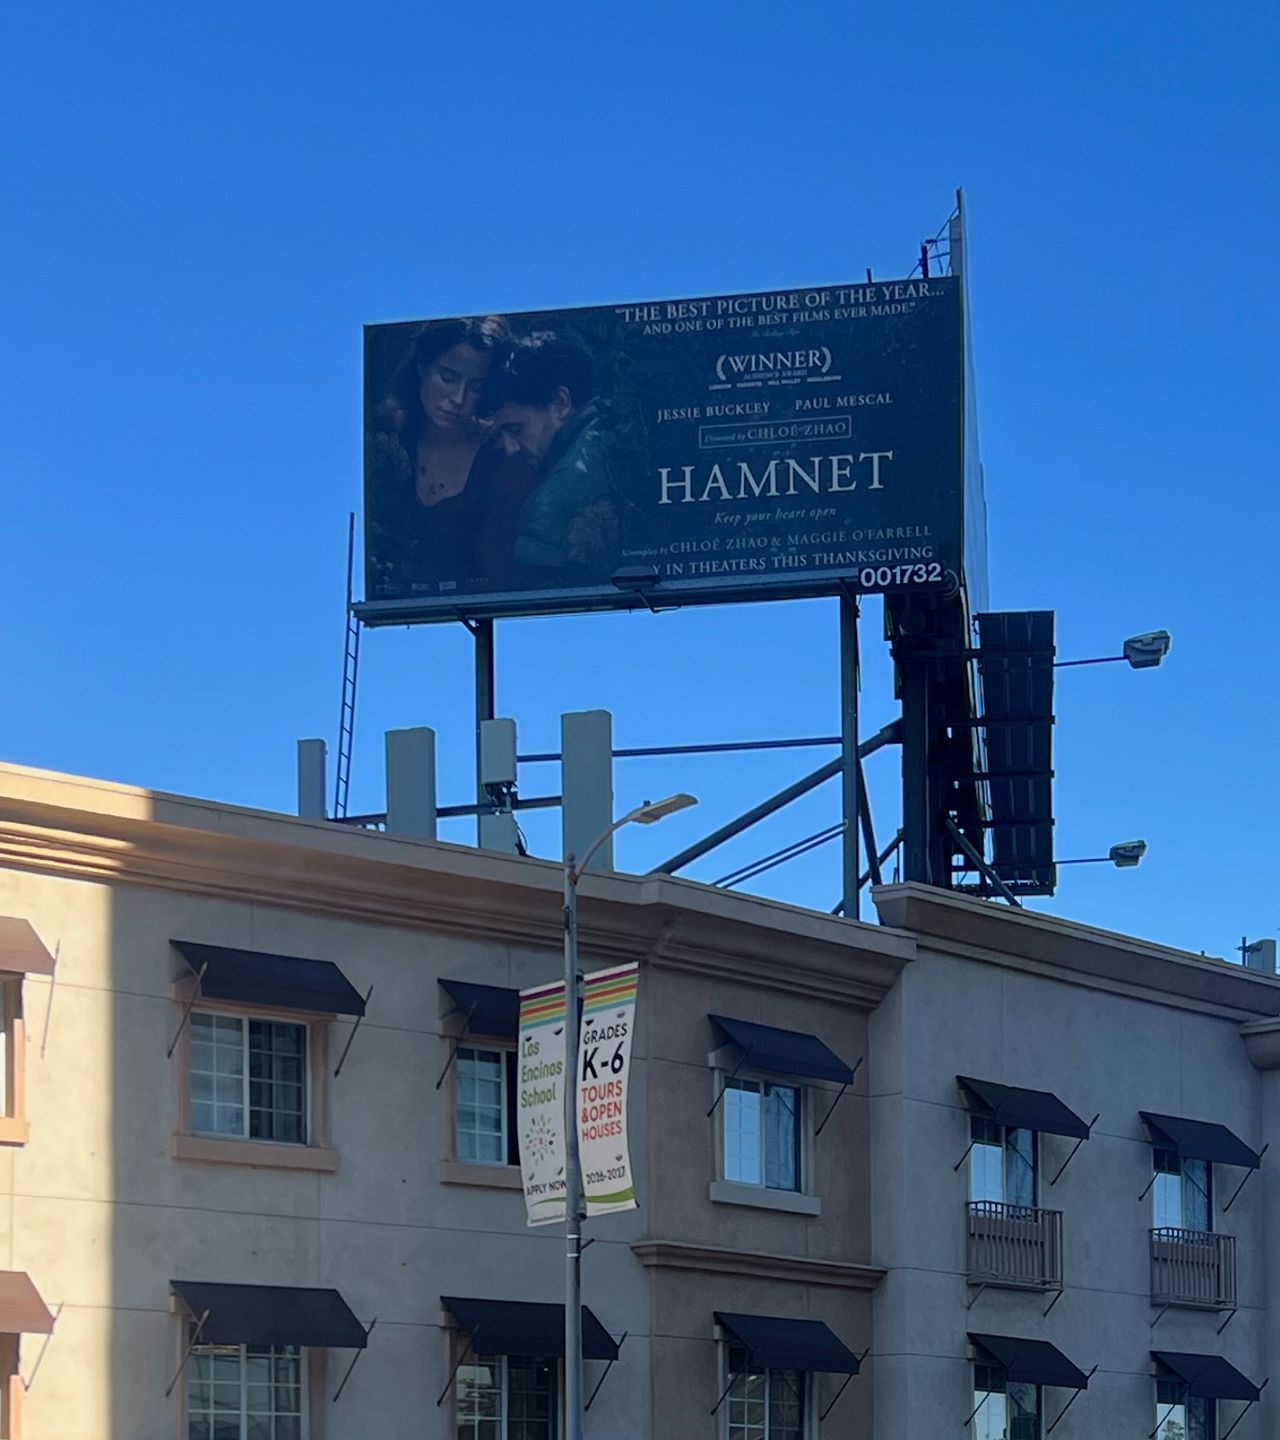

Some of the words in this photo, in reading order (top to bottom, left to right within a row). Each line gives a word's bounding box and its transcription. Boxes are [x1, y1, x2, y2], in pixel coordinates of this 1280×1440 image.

[667, 301, 711, 320] BEST
[717, 295, 798, 316] PICTURE
[805, 292, 831, 308] OF
[835, 288, 877, 305] THE
[642, 323, 671, 336] AND
[674, 320, 703, 333] ONE
[706, 318, 724, 330] OF
[727, 316, 755, 329] THE
[758, 313, 788, 327] BEST
[792, 310, 830, 324] FILMS
[834, 306, 867, 320] EVER
[729, 349, 823, 373] WINNER
[656, 405, 701, 423] JESSIE
[705, 402, 771, 419] BUCKLEY
[794, 397, 831, 411] PAUL
[836, 392, 894, 409] MESCAL
[803, 421, 847, 437] ZHAO
[657, 450, 894, 505] HAMNET
[714, 511, 740, 526] Keep
[745, 512, 772, 525] your
[775, 507, 805, 521] heart
[809, 507, 837, 521] open
[725, 535, 768, 550] ZHAO
[770, 536, 781, 548] &
[786, 530, 847, 547] MAGGIE
[852, 524, 932, 542] O'FARRELL
[665, 562, 684, 576] IN
[688, 557, 766, 575] THEATERS
[771, 553, 807, 568] THIS
[812, 546, 934, 565] THANKSGIVING
[860, 562, 942, 588] 001732
[583, 1021, 628, 1045] GRADES
[521, 1040, 540, 1059] Los
[582, 1041, 625, 1082] K-6
[521, 1059, 563, 1084] Encinos
[521, 1083, 556, 1109] School
[581, 1079, 623, 1104] TOURS
[581, 1122, 623, 1143] HOUSES
[526, 1180, 547, 1197] APPLY
[548, 1178, 567, 1193] NOW
